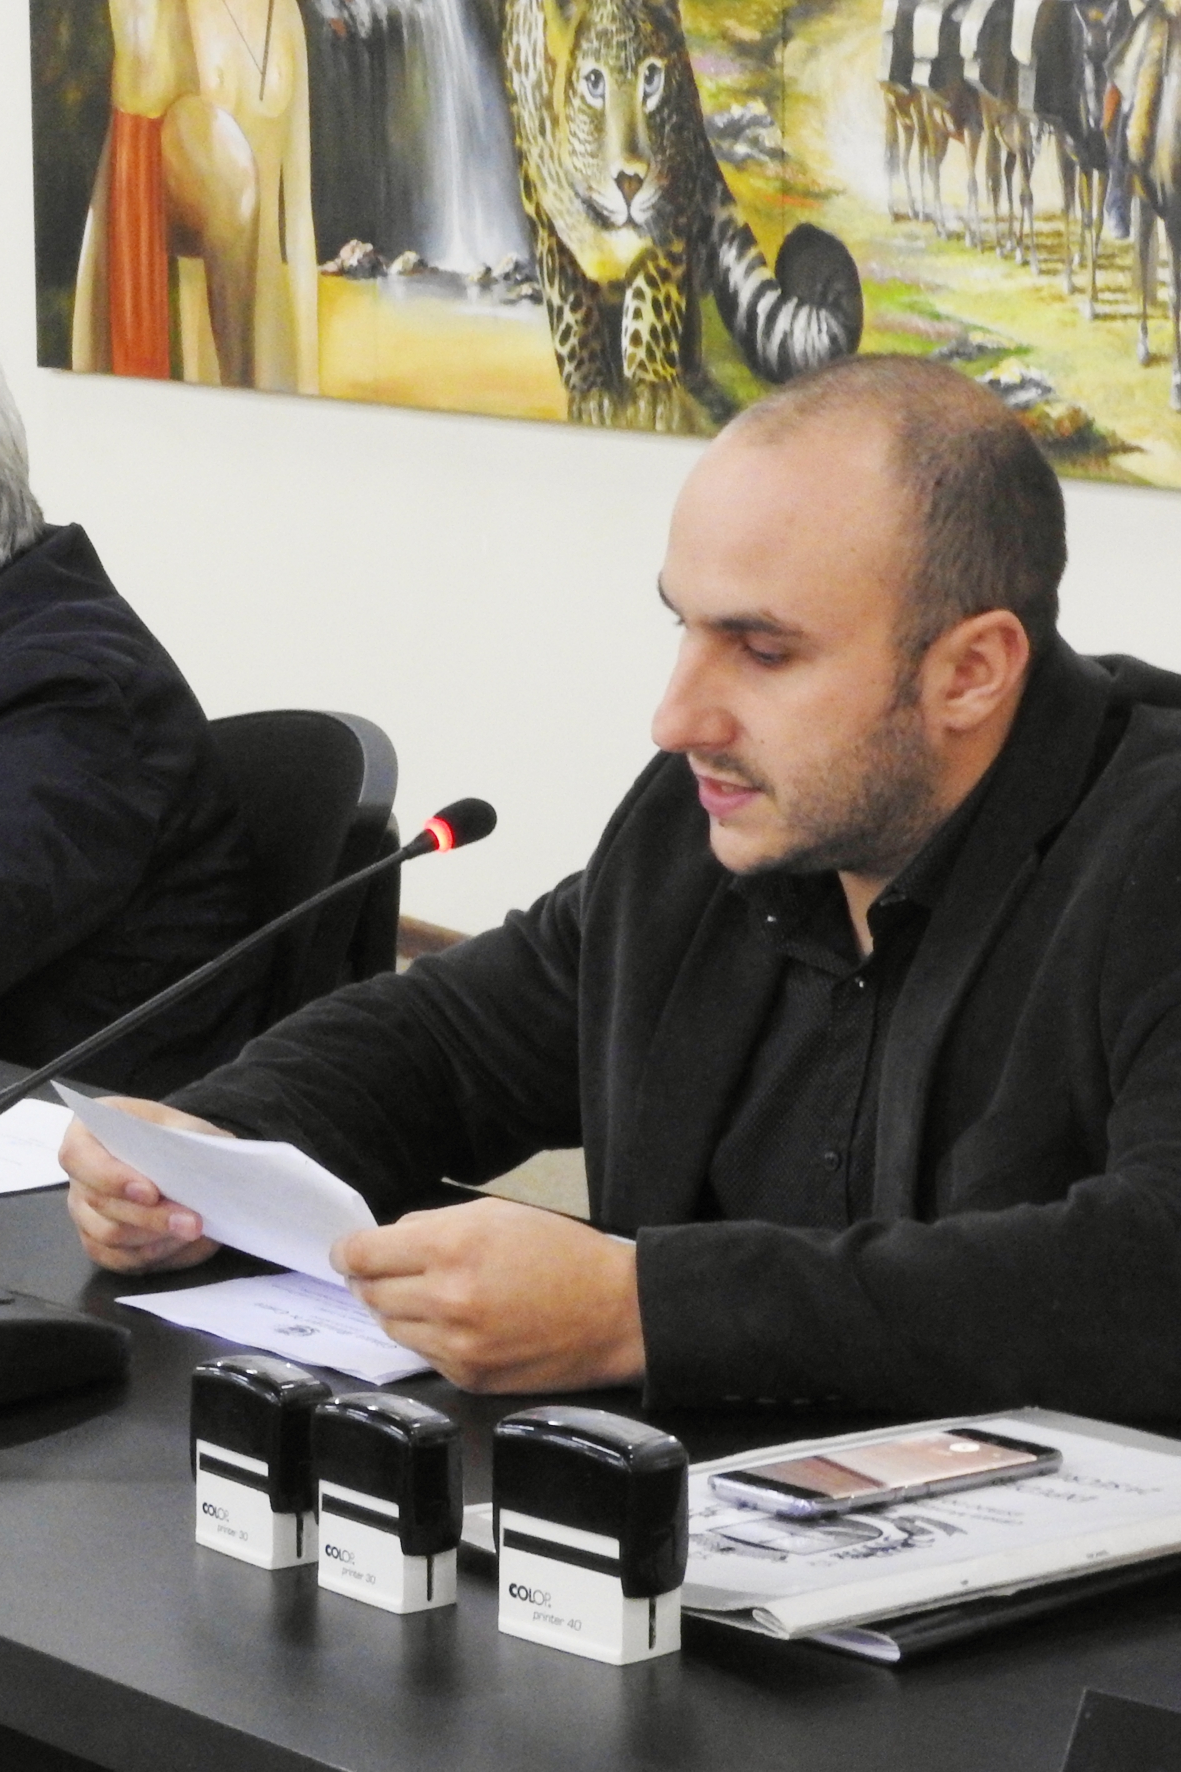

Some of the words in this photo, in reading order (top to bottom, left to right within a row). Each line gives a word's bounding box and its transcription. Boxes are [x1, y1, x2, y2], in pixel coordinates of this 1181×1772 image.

[239, 1530, 249, 1541] 30
[341, 1566, 364, 1580] printer
[365, 1573, 376, 1585] 30
[533, 1611, 564, 1626] printer
[567, 1619, 582, 1631] 40
